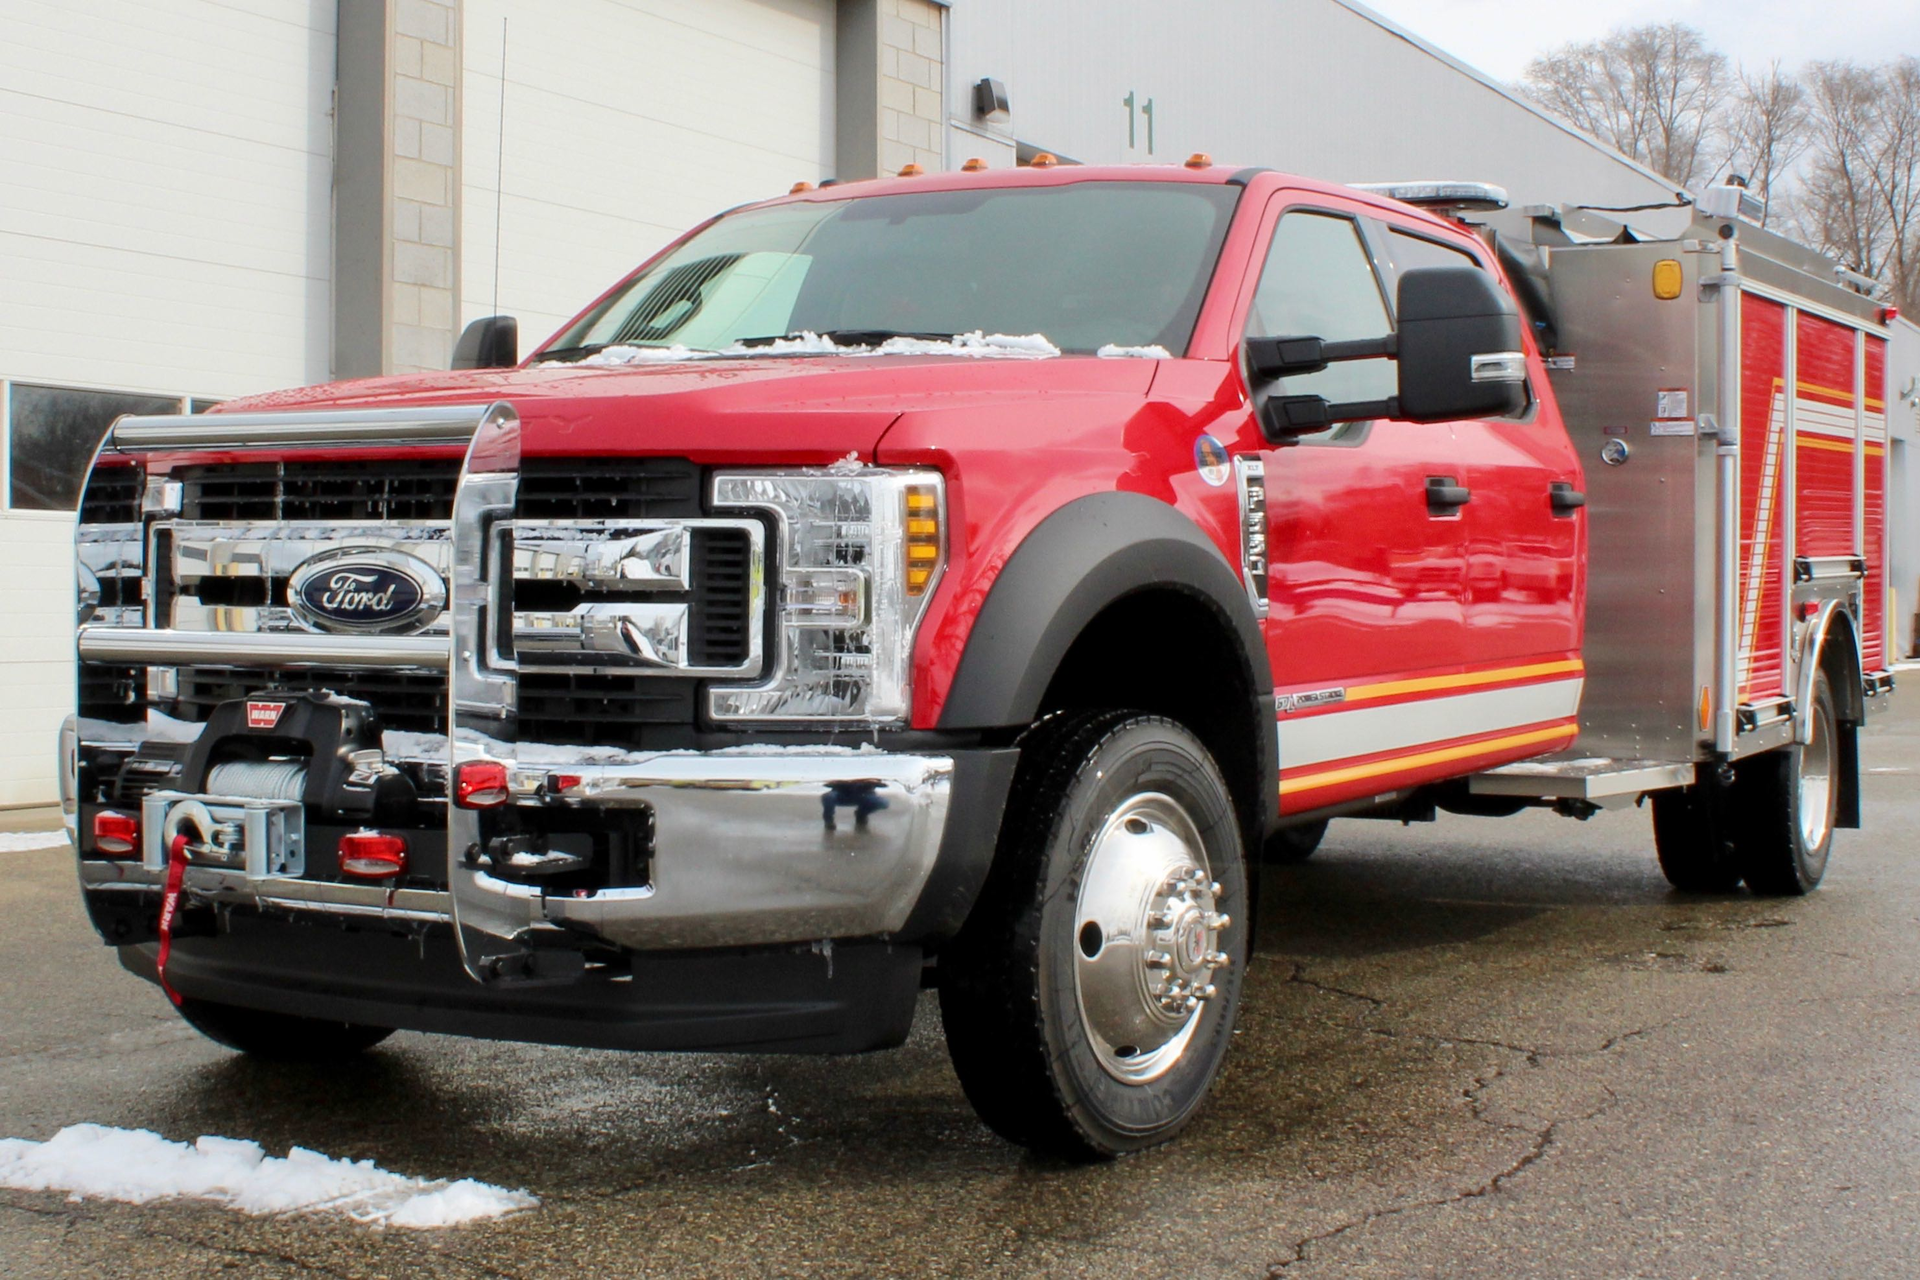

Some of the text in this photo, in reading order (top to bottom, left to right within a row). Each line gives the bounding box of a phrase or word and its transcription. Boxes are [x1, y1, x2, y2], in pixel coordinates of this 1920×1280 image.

[1123, 90, 1153, 155] 11
[322, 571, 397, 611] Ford
[251, 709, 278, 720] WARN
[160, 892, 178, 931] WARN
